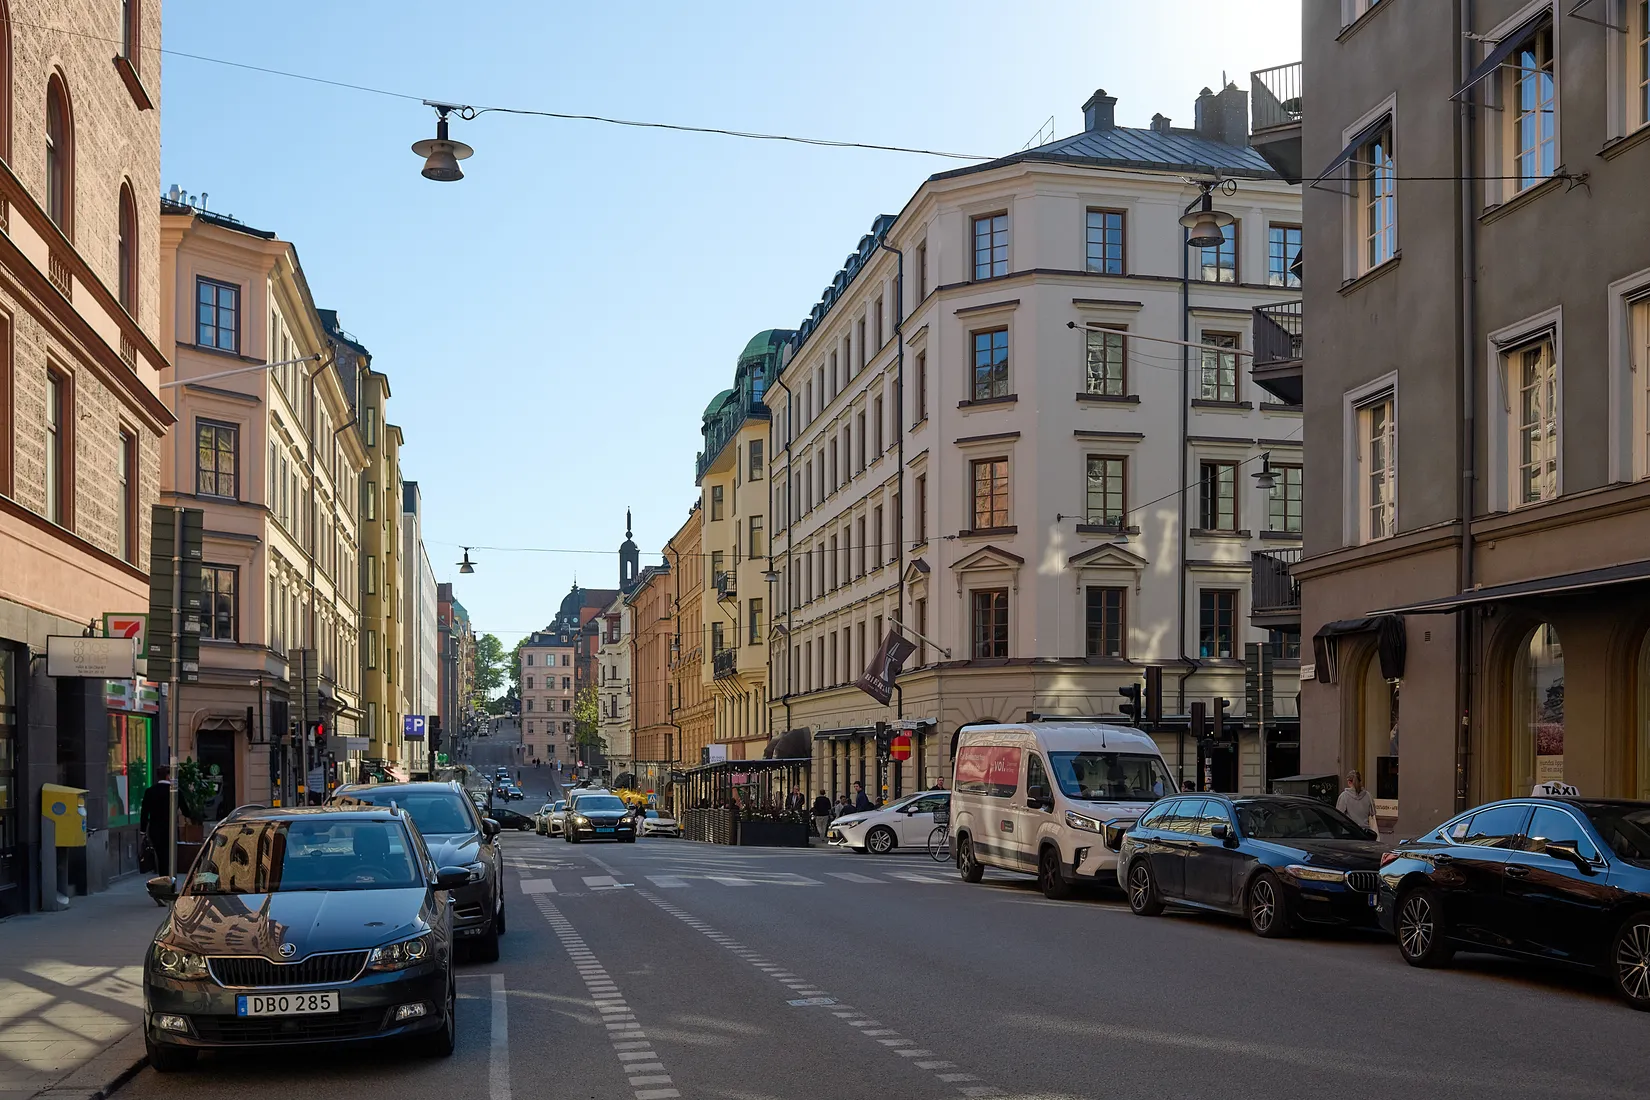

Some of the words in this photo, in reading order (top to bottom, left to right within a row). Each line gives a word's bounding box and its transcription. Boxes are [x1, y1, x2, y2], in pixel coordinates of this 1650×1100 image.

[414, 718, 424, 731] P
[1542, 786, 1576, 795] TAXI
[296, 994, 331, 1011] 285
